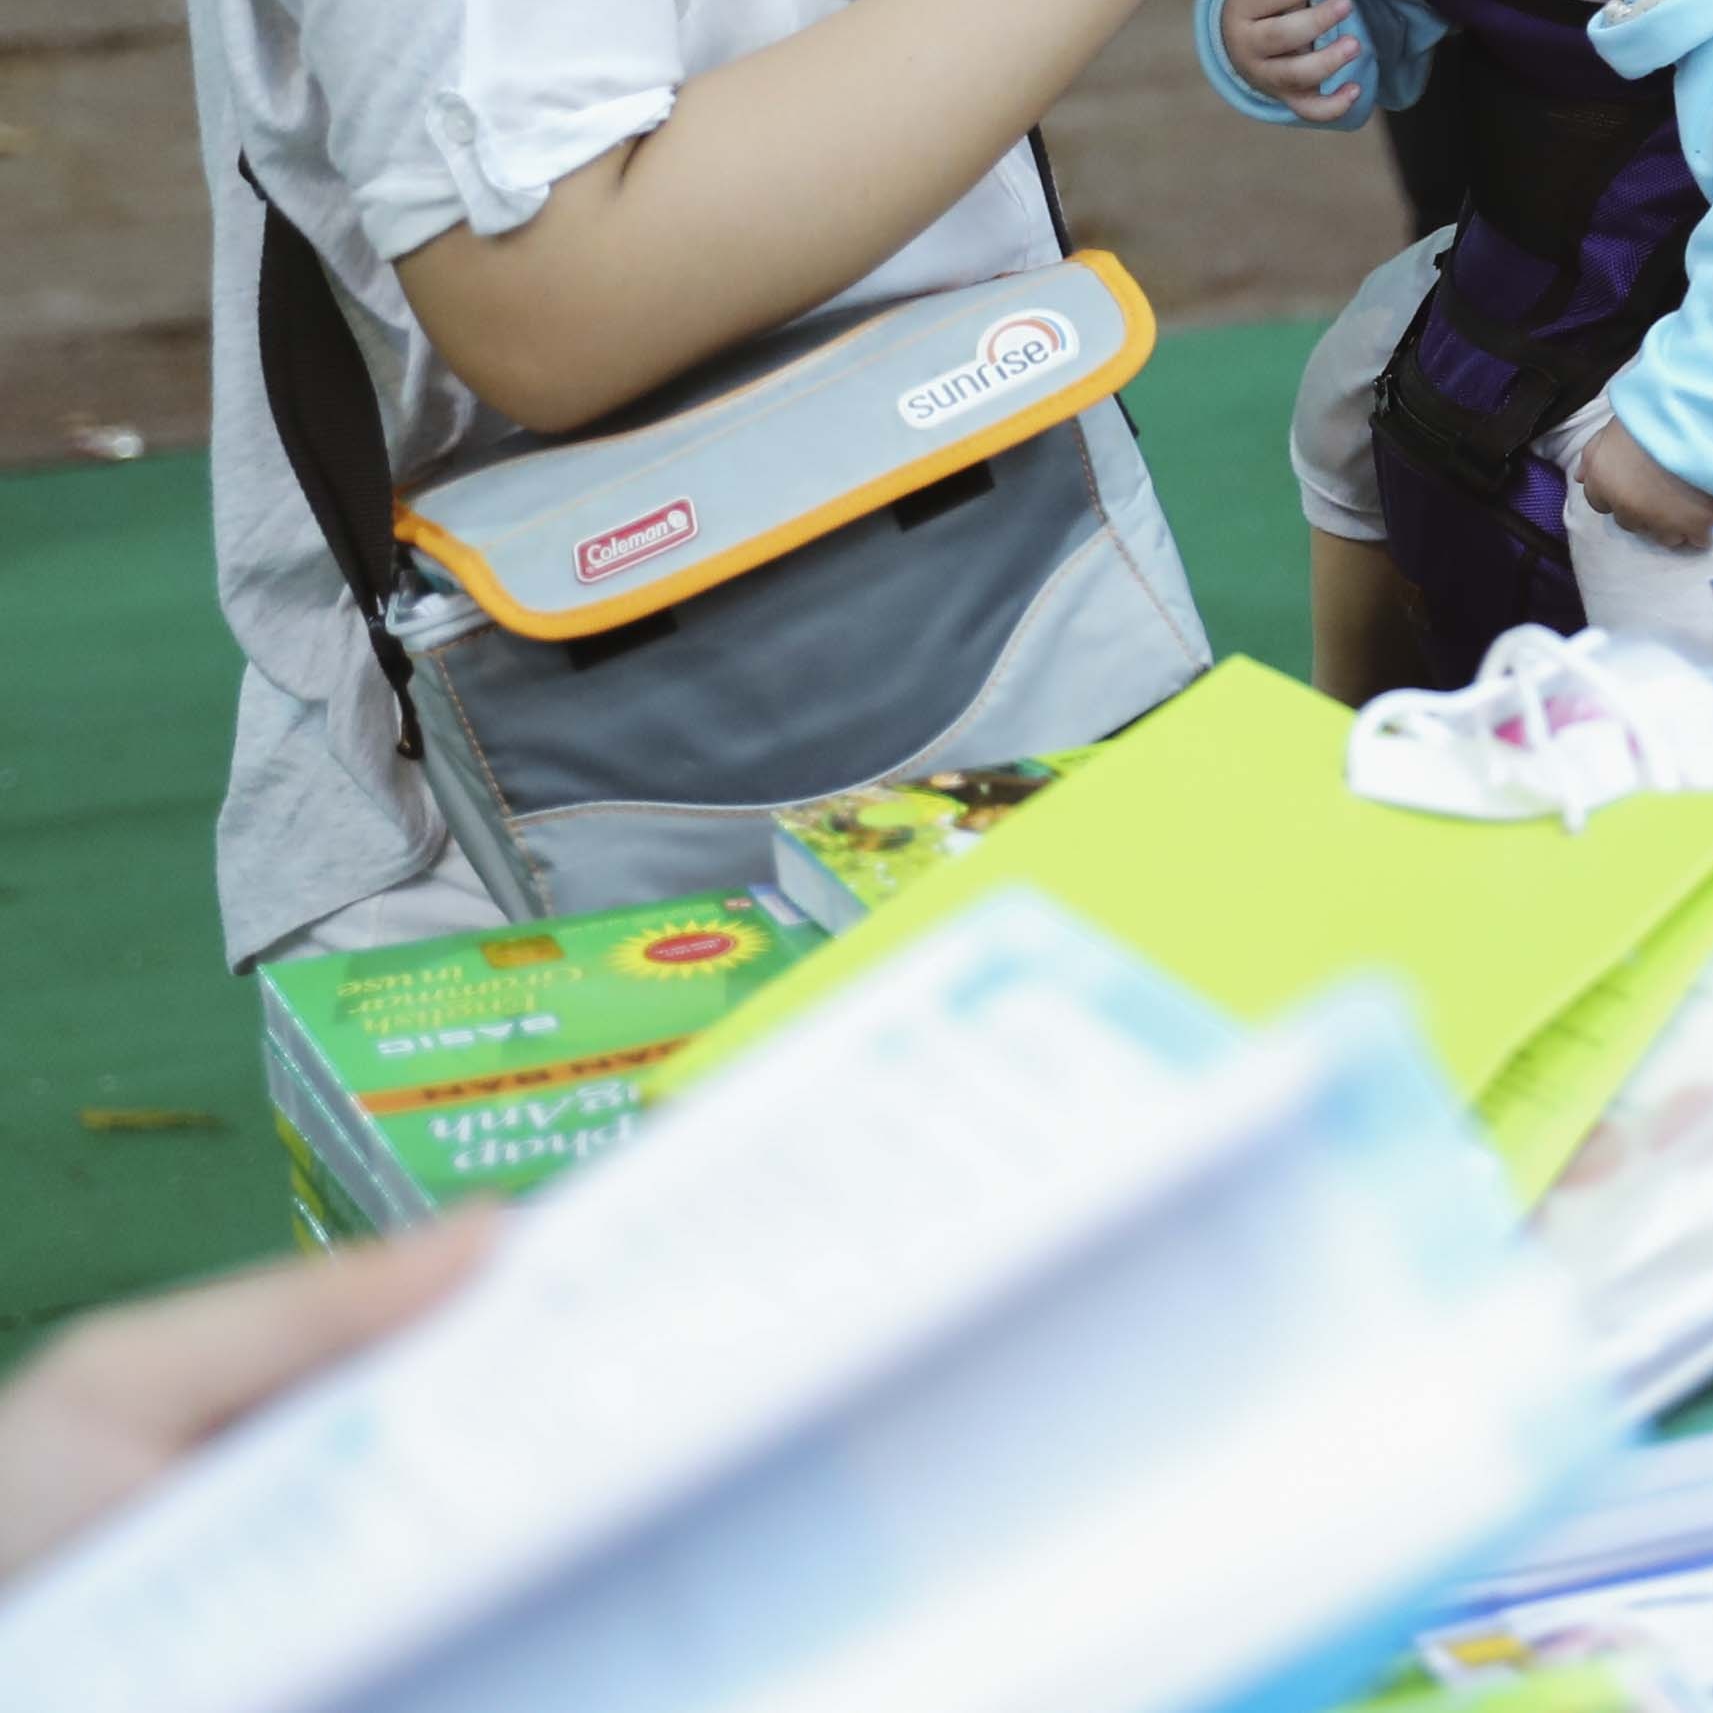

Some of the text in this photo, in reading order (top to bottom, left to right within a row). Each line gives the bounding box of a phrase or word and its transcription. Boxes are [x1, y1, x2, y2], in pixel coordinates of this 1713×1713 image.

[907, 338, 1050, 421] sunrise
[586, 520, 669, 566] Coleman
[376, 1014, 560, 1057] BASIC
